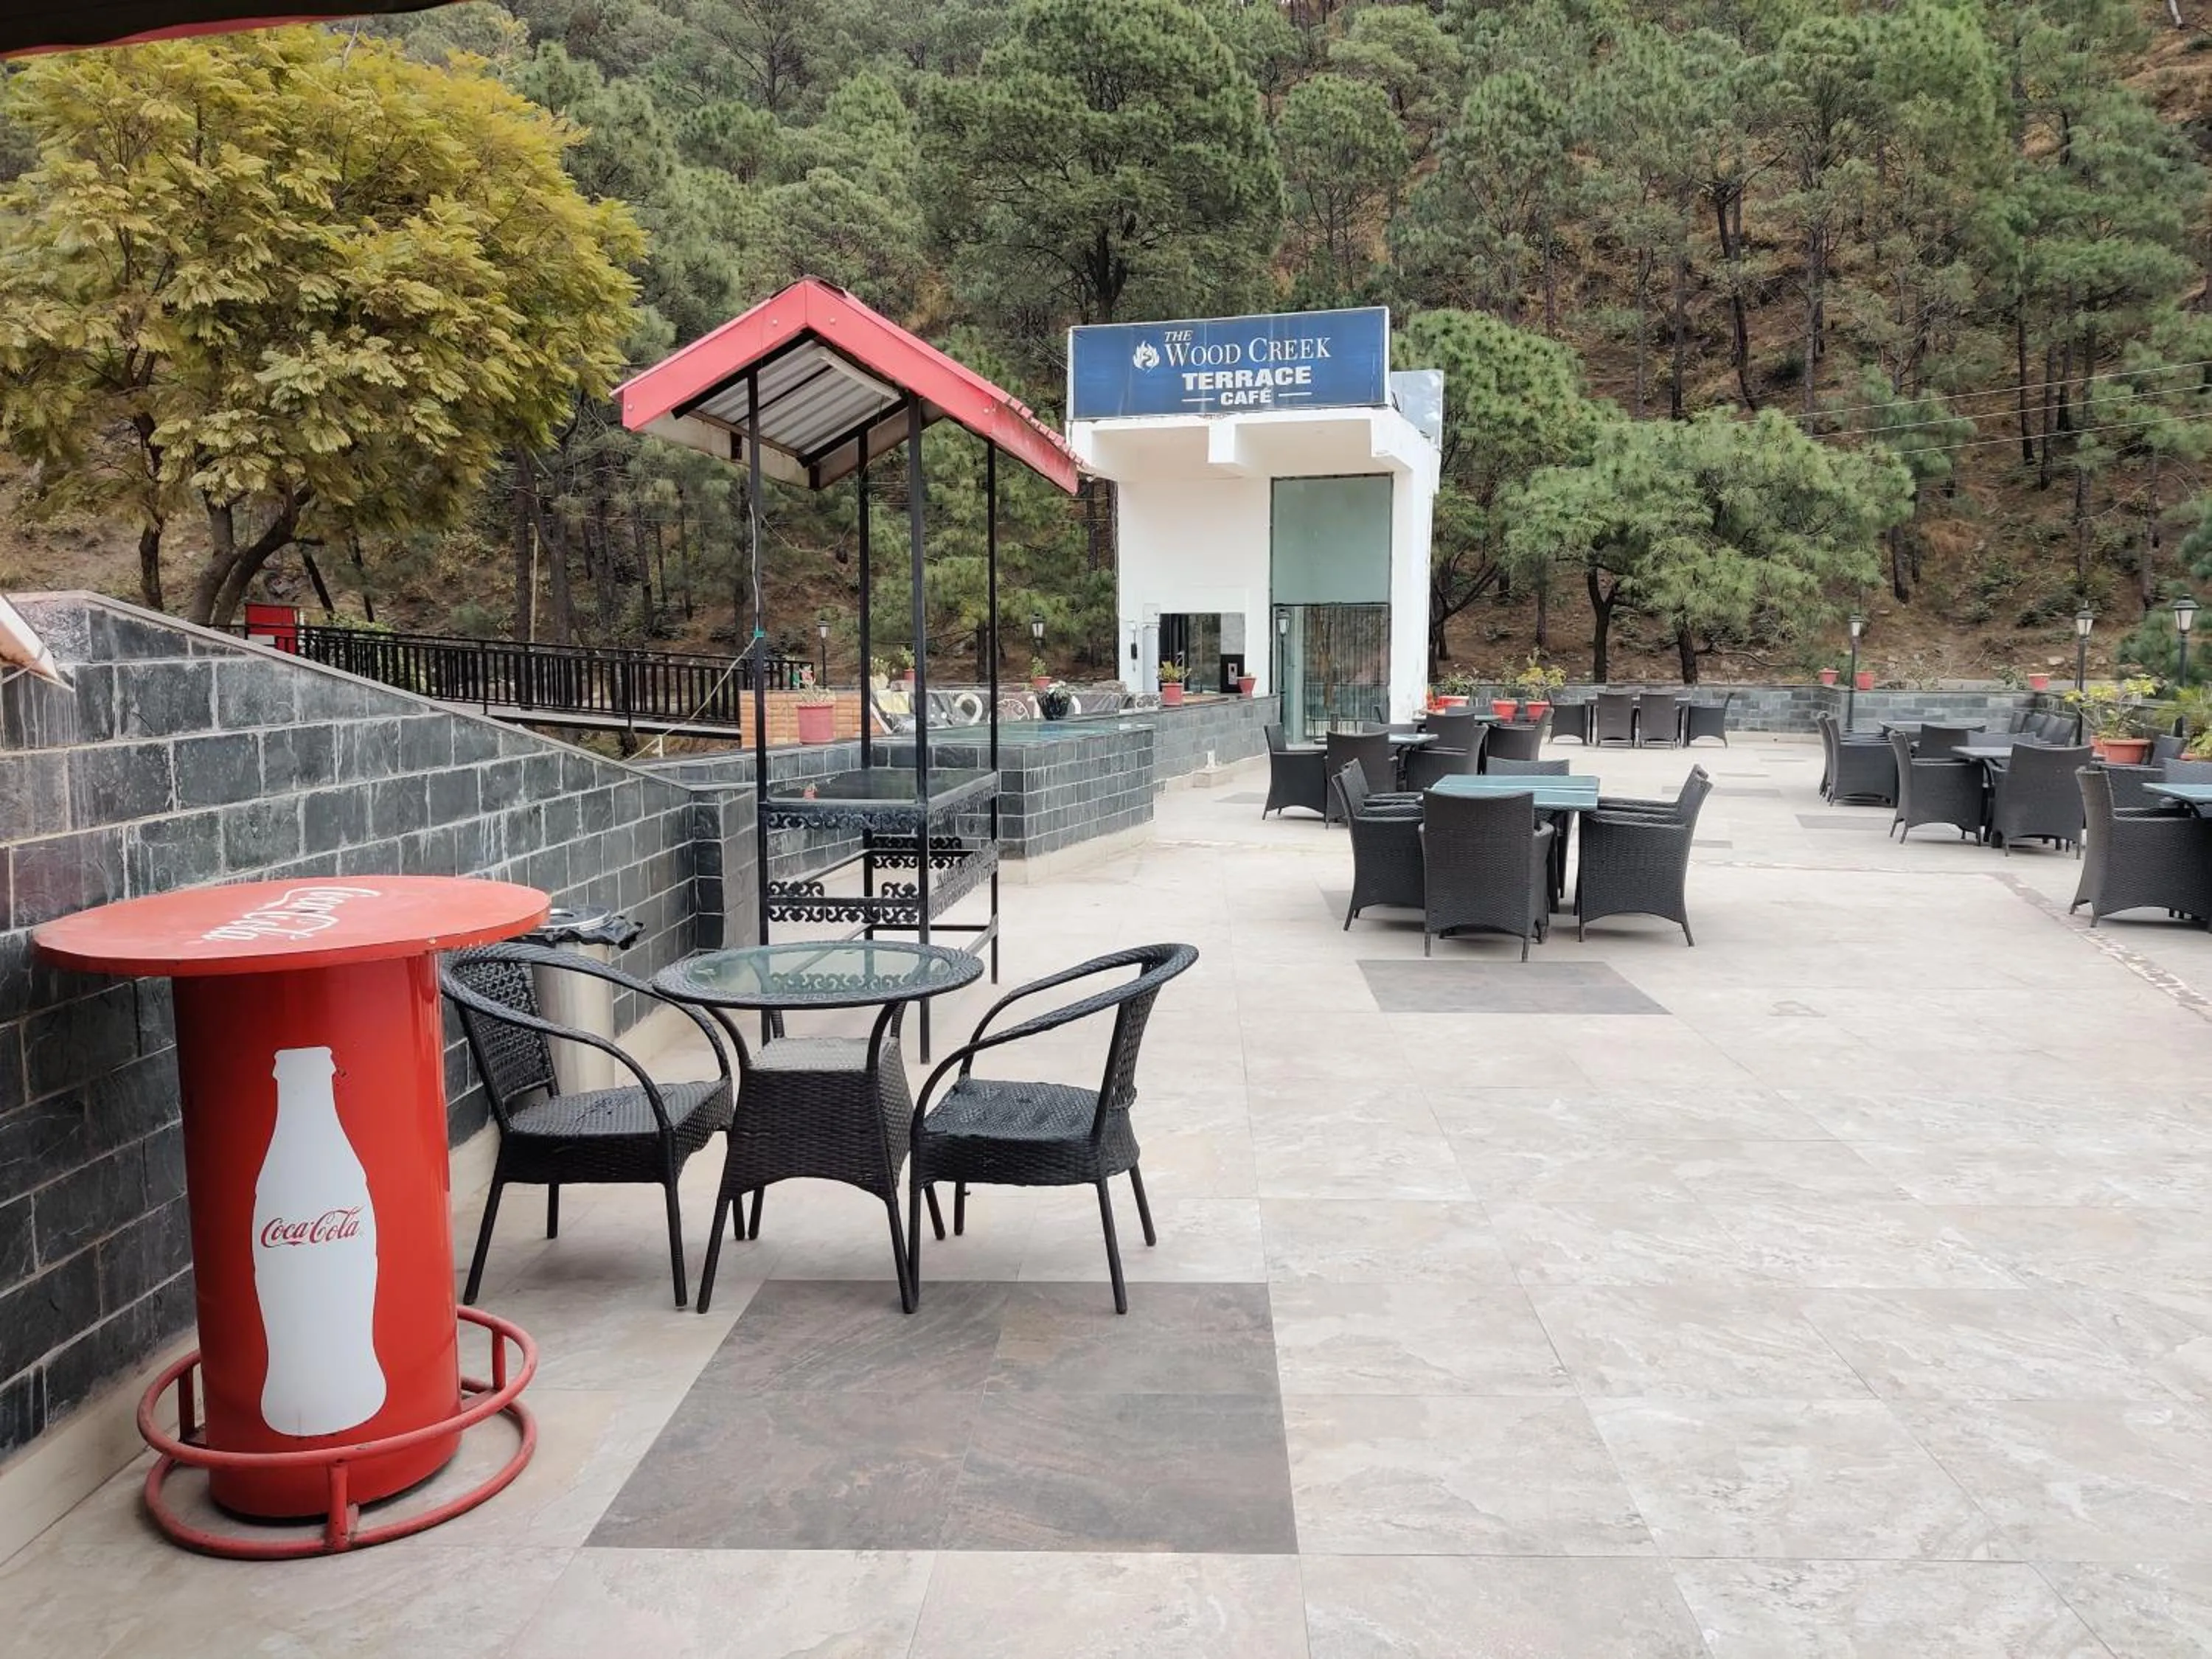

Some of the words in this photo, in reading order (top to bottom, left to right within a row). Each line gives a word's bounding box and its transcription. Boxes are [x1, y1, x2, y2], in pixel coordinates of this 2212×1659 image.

[1164, 330, 1193, 343] THE
[1164, 342, 1242, 367] WOOD
[1248, 336, 1332, 363] CREEK
[1181, 365, 1312, 392] TERRACE
[260, 1204, 366, 1249] Coca-Cola
